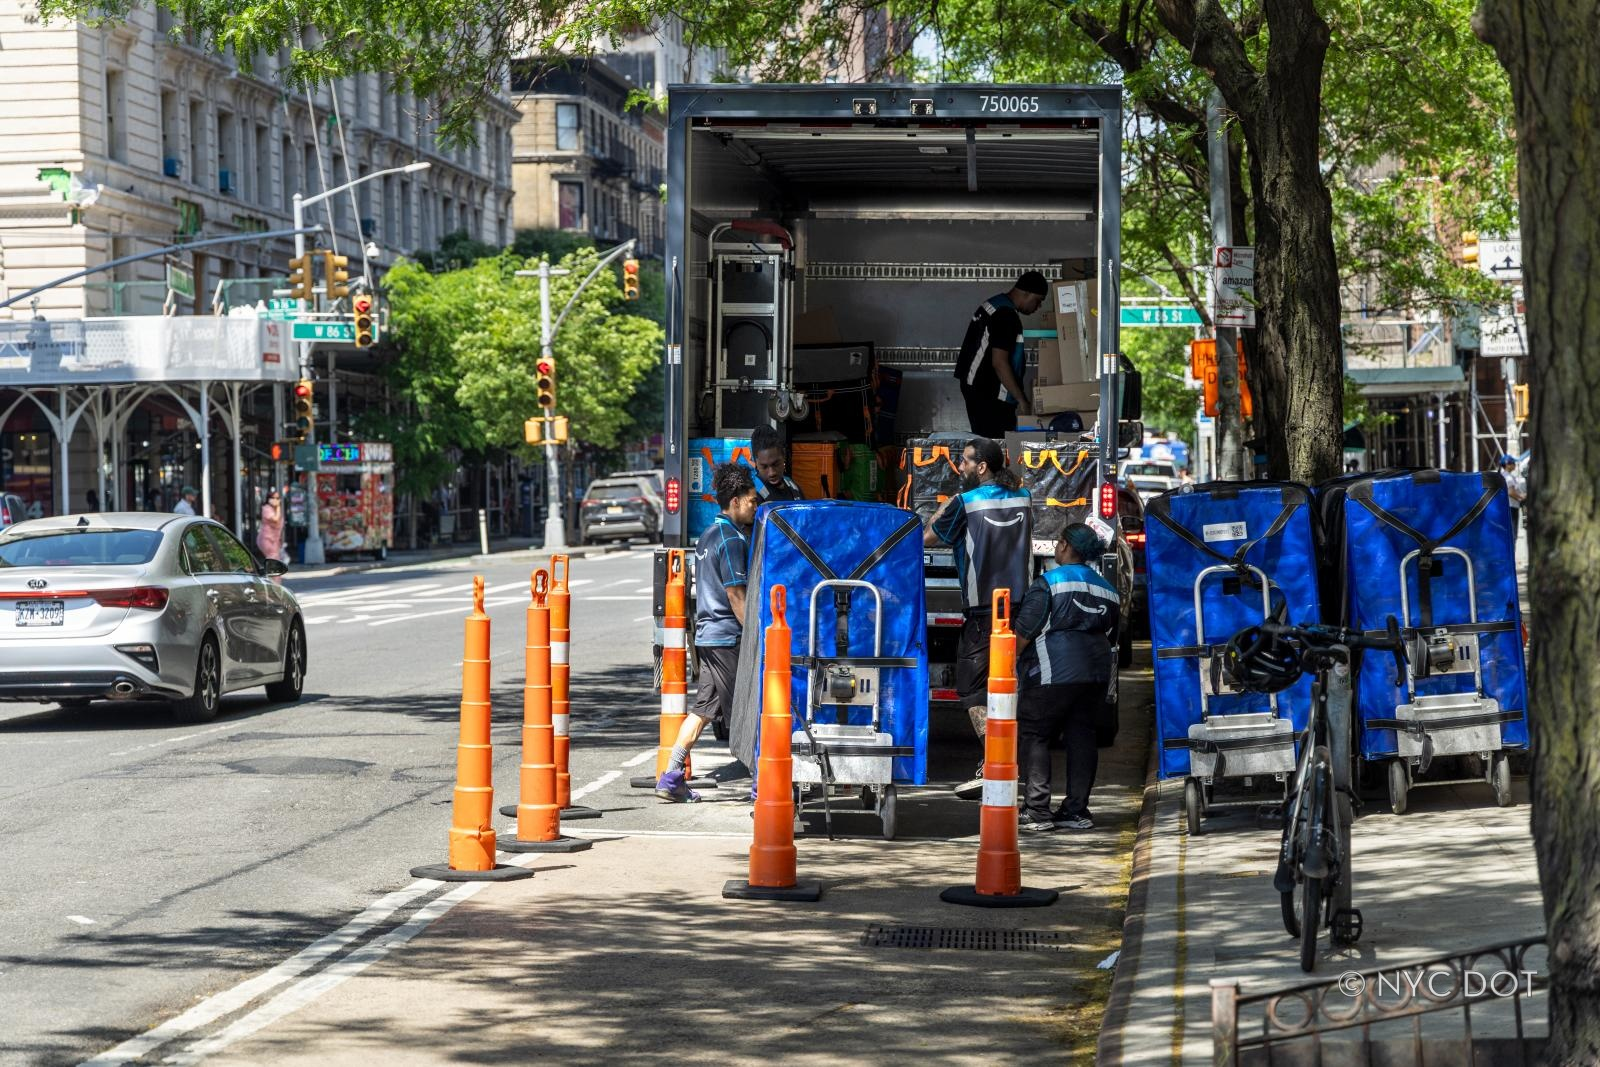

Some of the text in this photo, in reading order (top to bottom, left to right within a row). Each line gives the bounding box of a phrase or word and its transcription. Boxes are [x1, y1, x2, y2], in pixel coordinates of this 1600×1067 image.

[980, 96, 1039, 113] 750065
[1222, 277, 1253, 286] amazon
[1142, 310, 1152, 322] W
[1154, 310, 1169, 322] 86
[314, 326, 324, 337] W
[326, 326, 340, 337] 86
